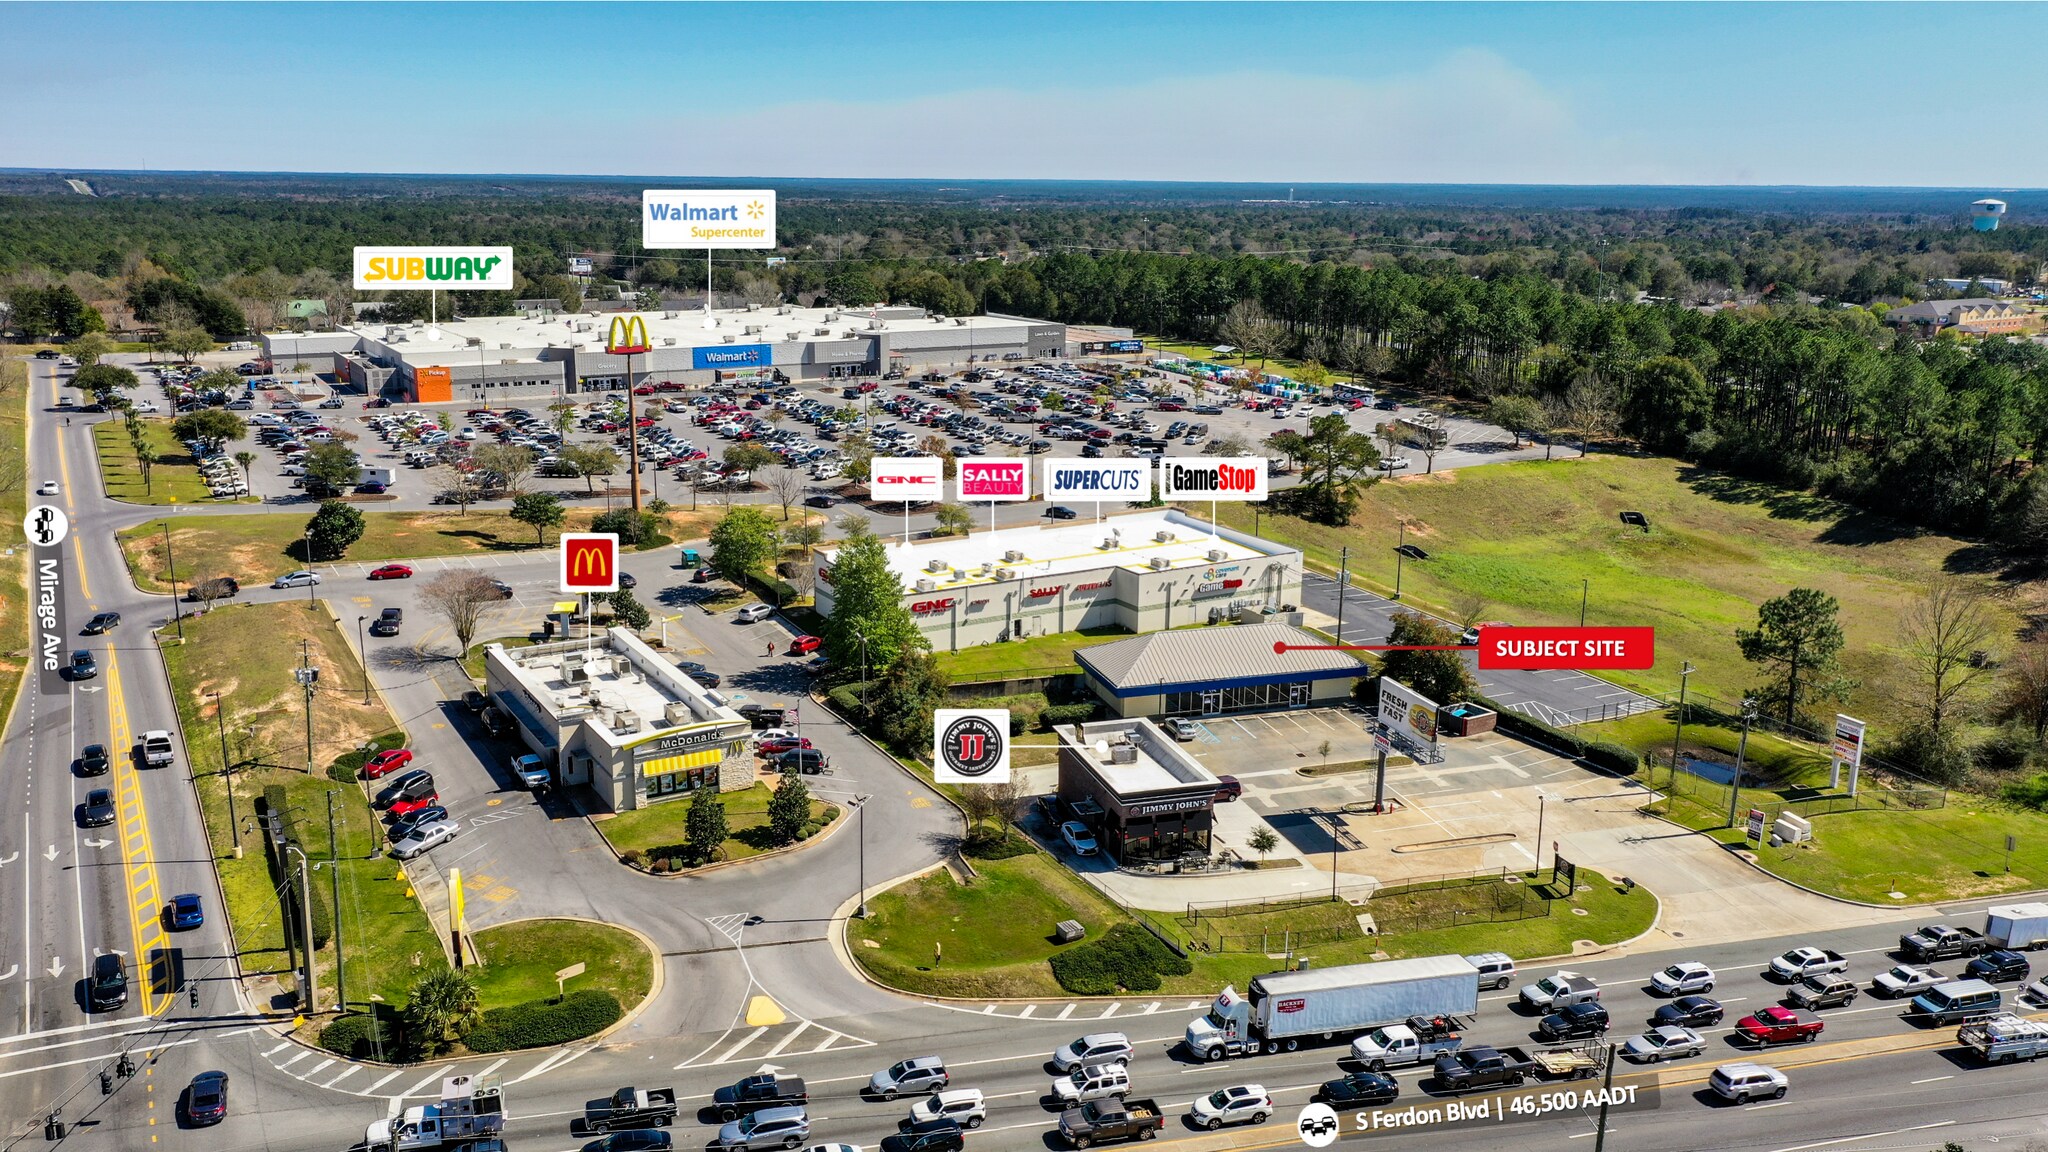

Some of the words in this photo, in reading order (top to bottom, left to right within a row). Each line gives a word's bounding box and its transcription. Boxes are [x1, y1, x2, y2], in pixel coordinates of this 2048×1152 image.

[706, 352, 747, 363] Walmart
[1029, 585, 1061, 598] SALLY
[911, 598, 956, 613] GNC
[1381, 690, 1408, 710] FRESH
[1383, 706, 1404, 722] FAST
[660, 731, 725, 749] McDonald's
[1142, 803, 1174, 815] JIMMY
[1175, 800, 1208, 811] JOHN'S
